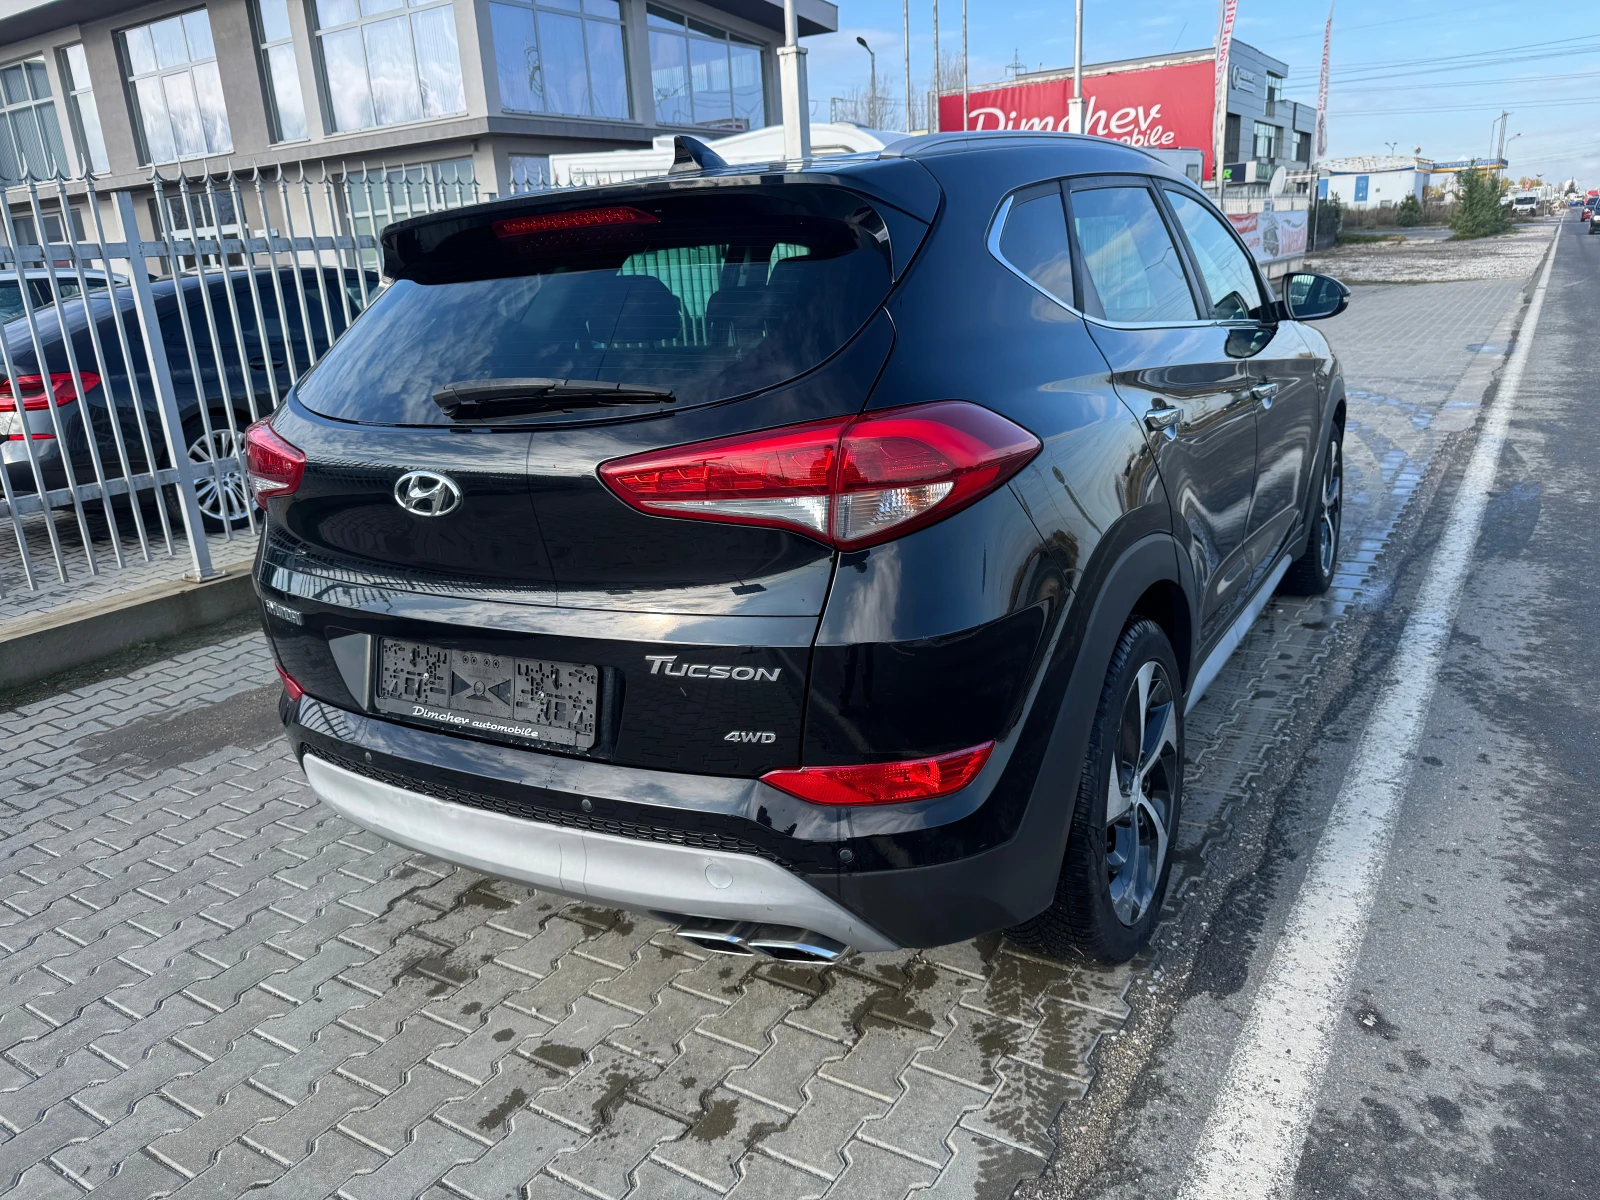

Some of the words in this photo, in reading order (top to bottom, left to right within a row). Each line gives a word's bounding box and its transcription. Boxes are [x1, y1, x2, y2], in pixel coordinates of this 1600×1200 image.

[645, 655, 782, 682] TUCSON
[412, 705, 469, 725] Dimchev
[472, 719, 539, 738] automobile
[724, 731, 776, 744] 4WD
